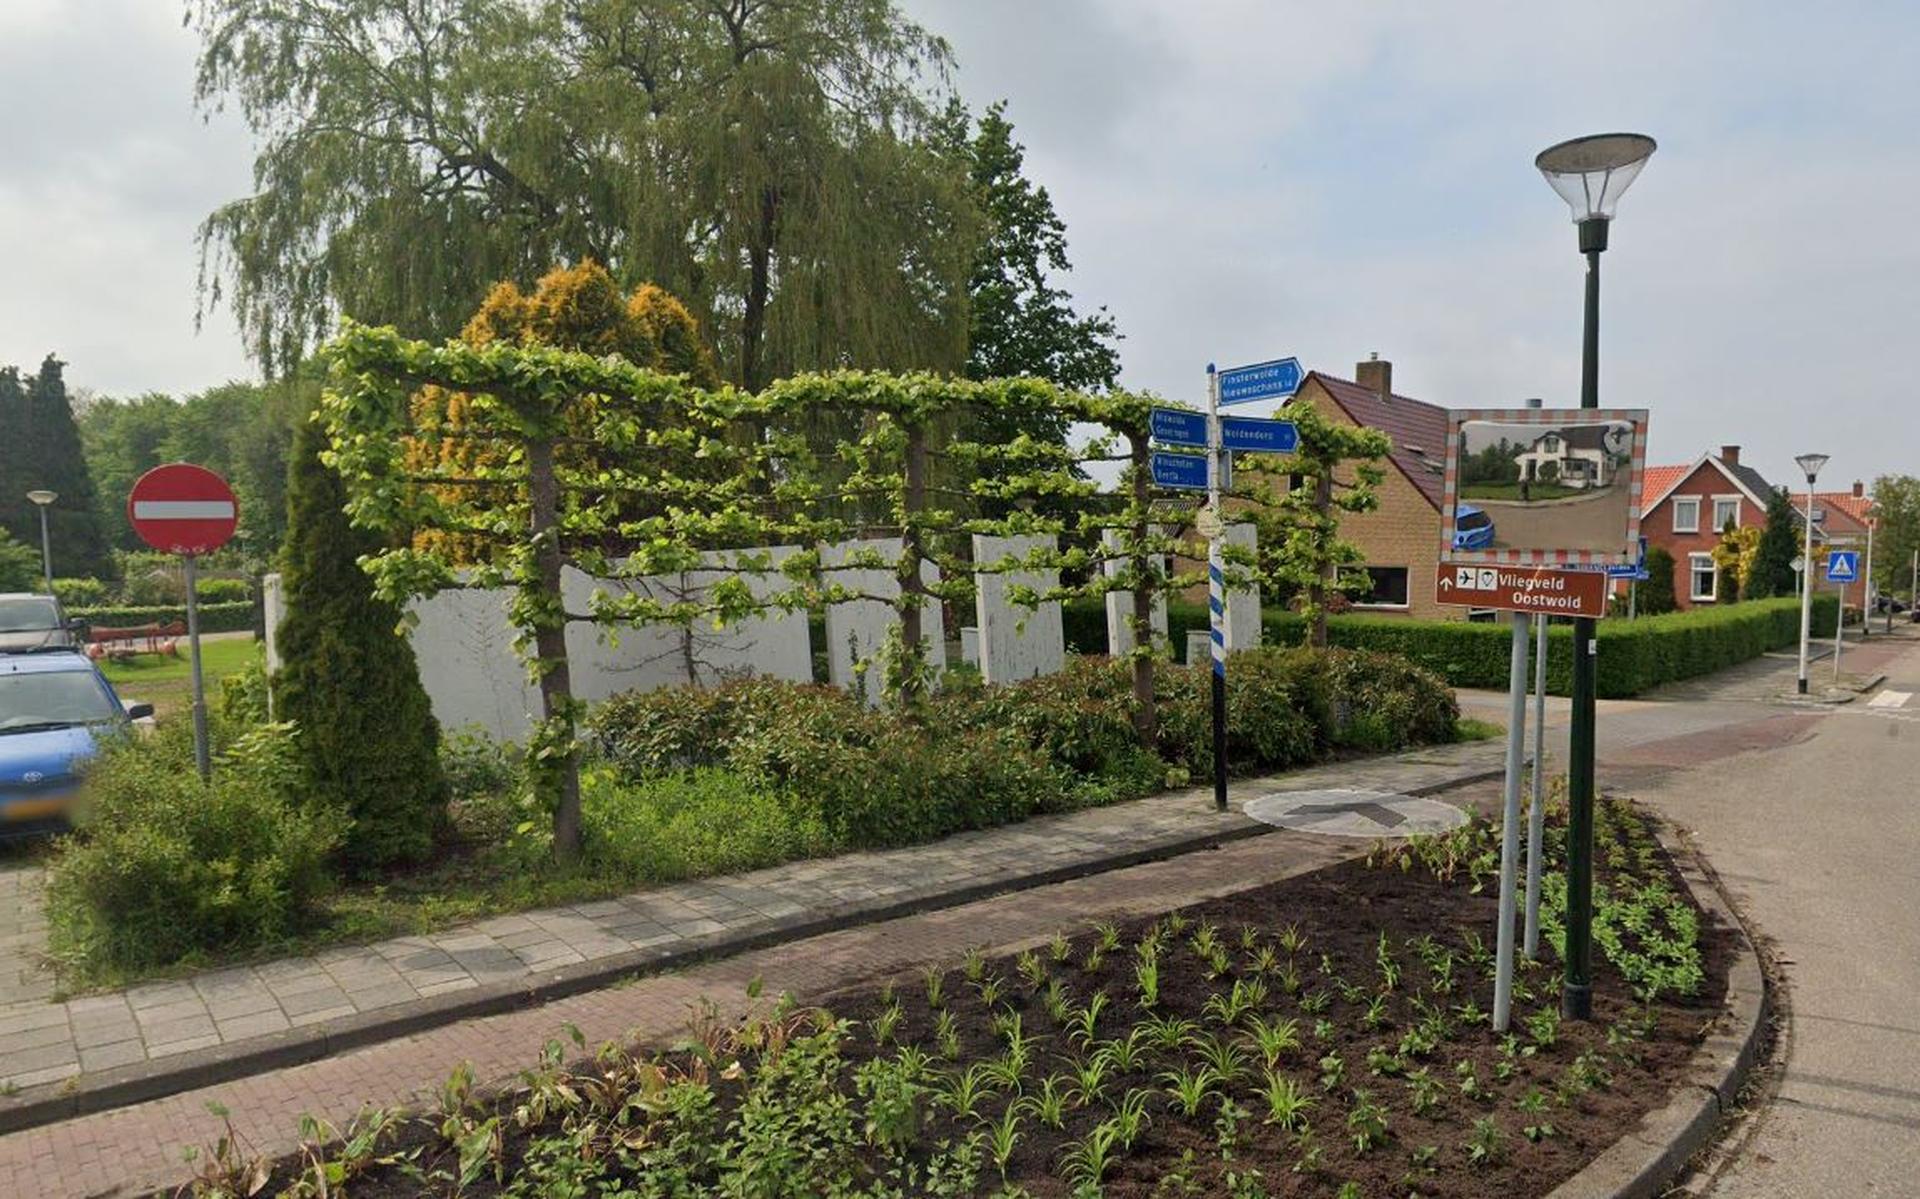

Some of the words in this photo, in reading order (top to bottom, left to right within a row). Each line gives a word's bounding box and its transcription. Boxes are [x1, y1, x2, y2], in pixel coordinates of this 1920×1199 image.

[1222, 367, 1280, 385] Finsterwolde
[1498, 574, 1565, 591] Vliegveld
[1512, 592, 1582, 609] Oostwold
